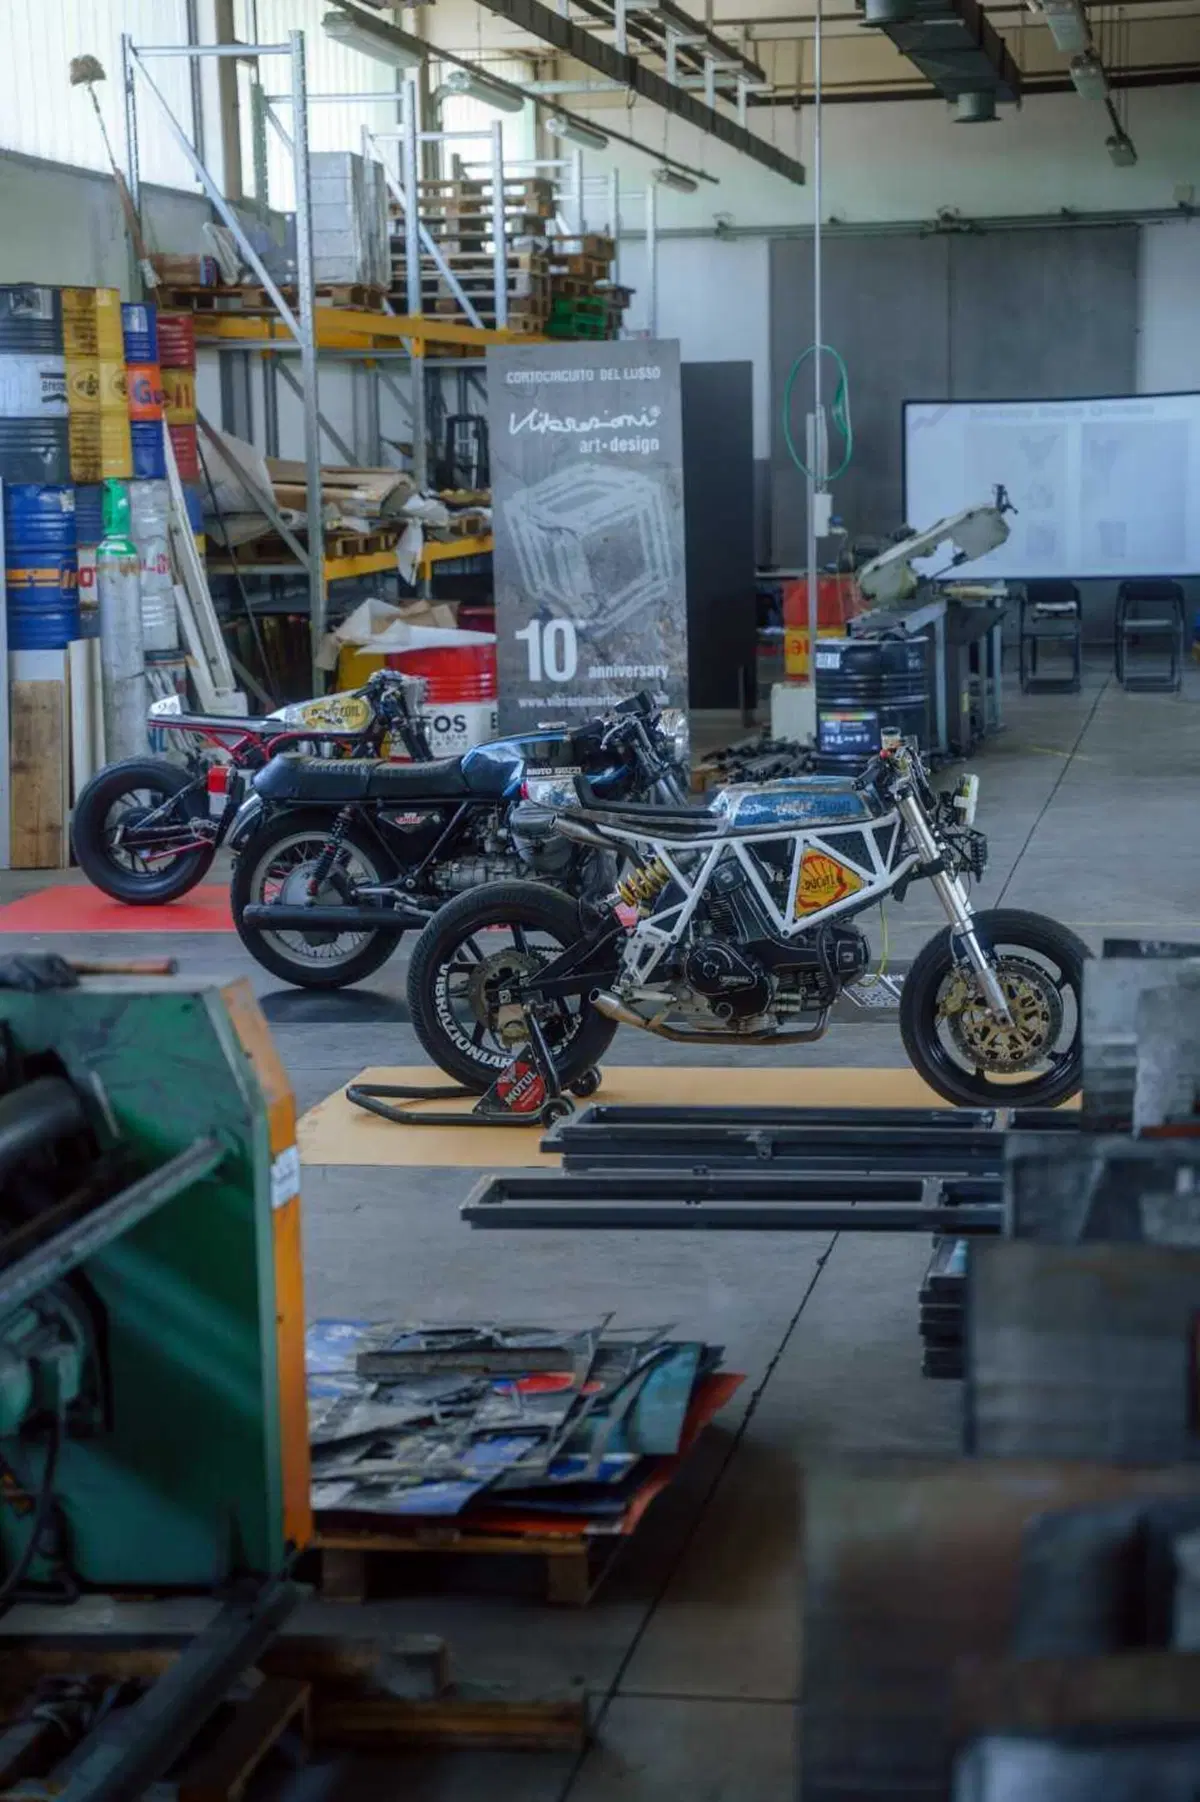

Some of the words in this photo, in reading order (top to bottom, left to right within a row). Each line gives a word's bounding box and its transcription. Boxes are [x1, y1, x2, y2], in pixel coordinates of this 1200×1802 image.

[506, 369, 594, 384] CORTOCIRCUITO
[600, 367, 620, 381] DEL
[624, 366, 661, 380] LUSSO
[515, 619, 577, 682] 10
[588, 664, 670, 681] anniversary
[504, 1070, 538, 1105] MOTUL
